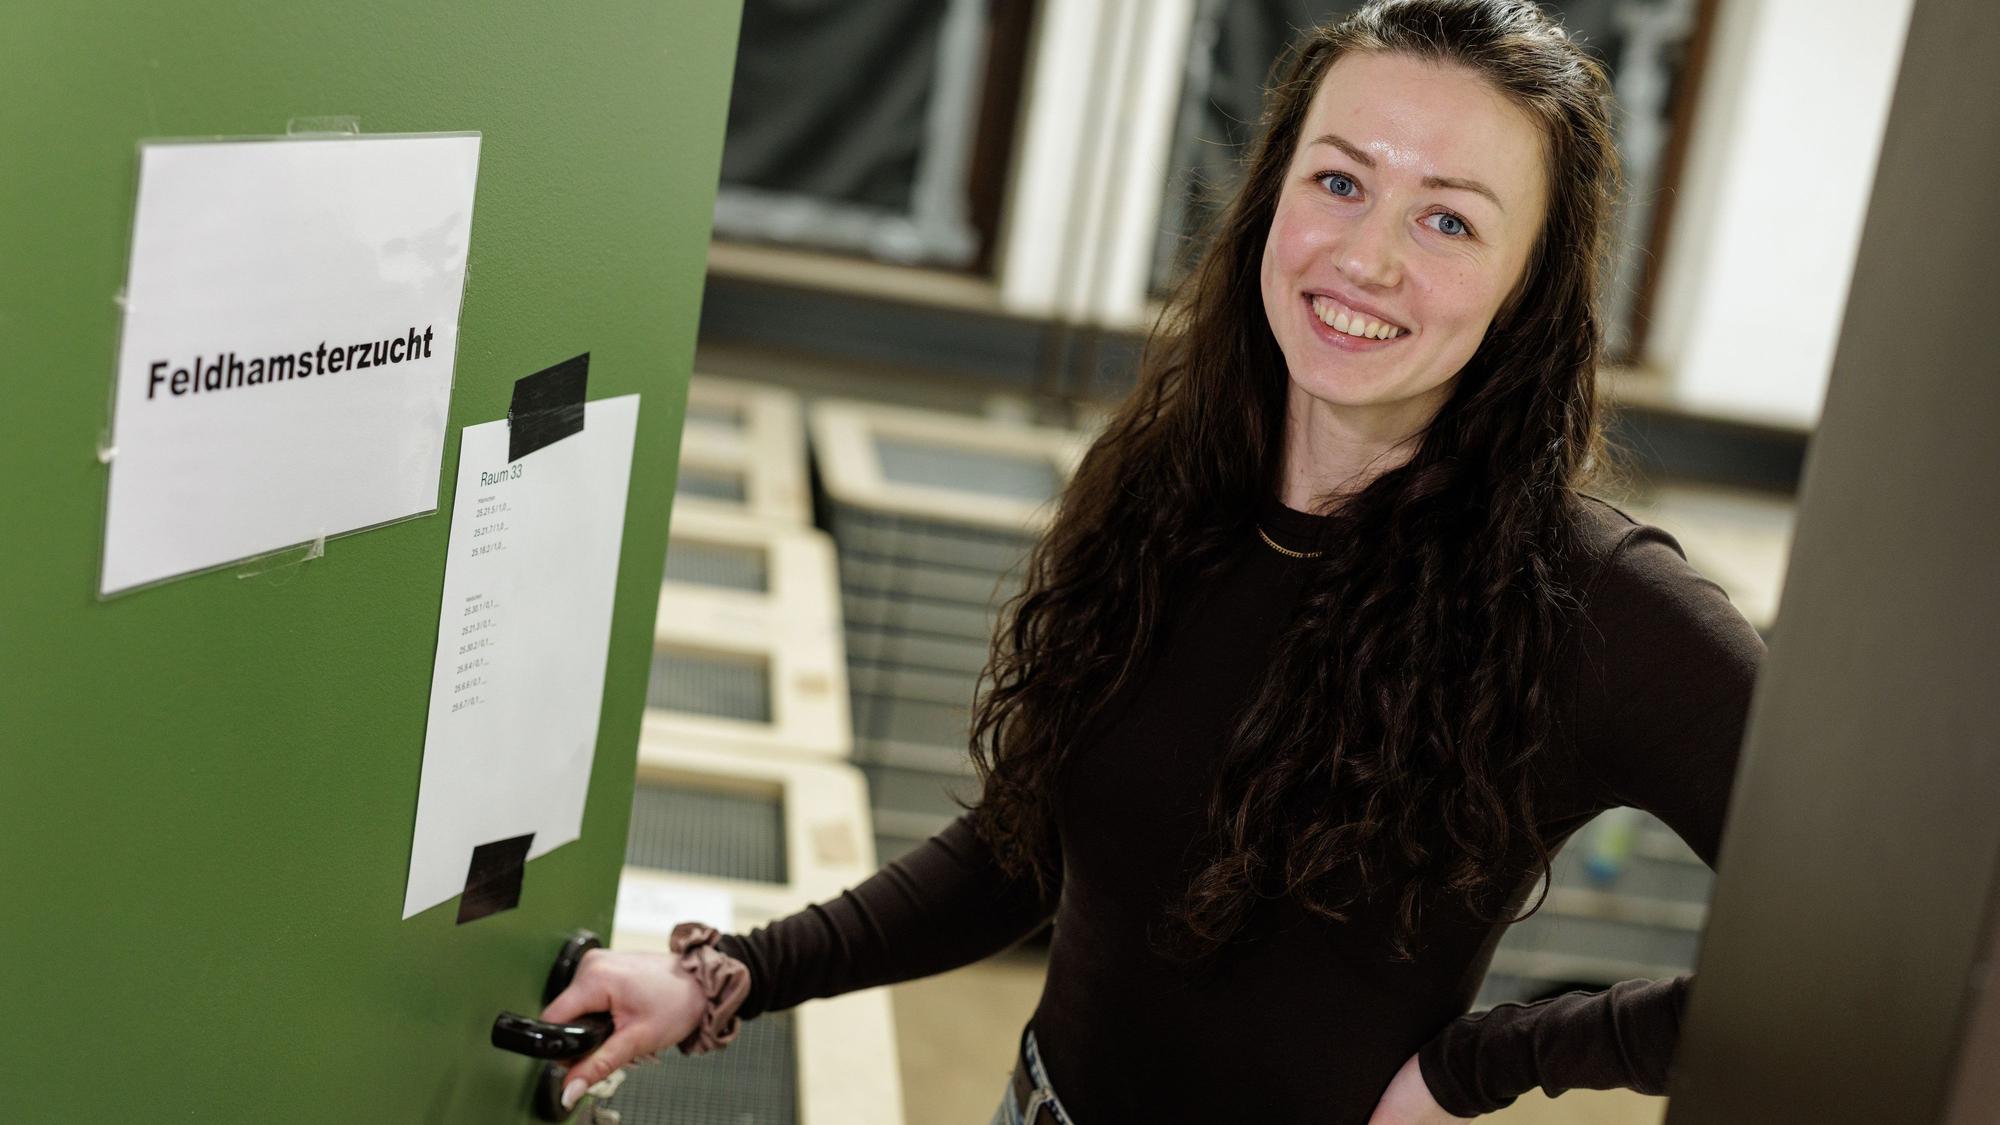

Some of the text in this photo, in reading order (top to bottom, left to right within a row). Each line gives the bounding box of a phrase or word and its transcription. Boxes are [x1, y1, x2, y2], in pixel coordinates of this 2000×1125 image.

[146, 324, 434, 400] Feldhamsterzucht
[480, 463, 523, 488] Raum 33
